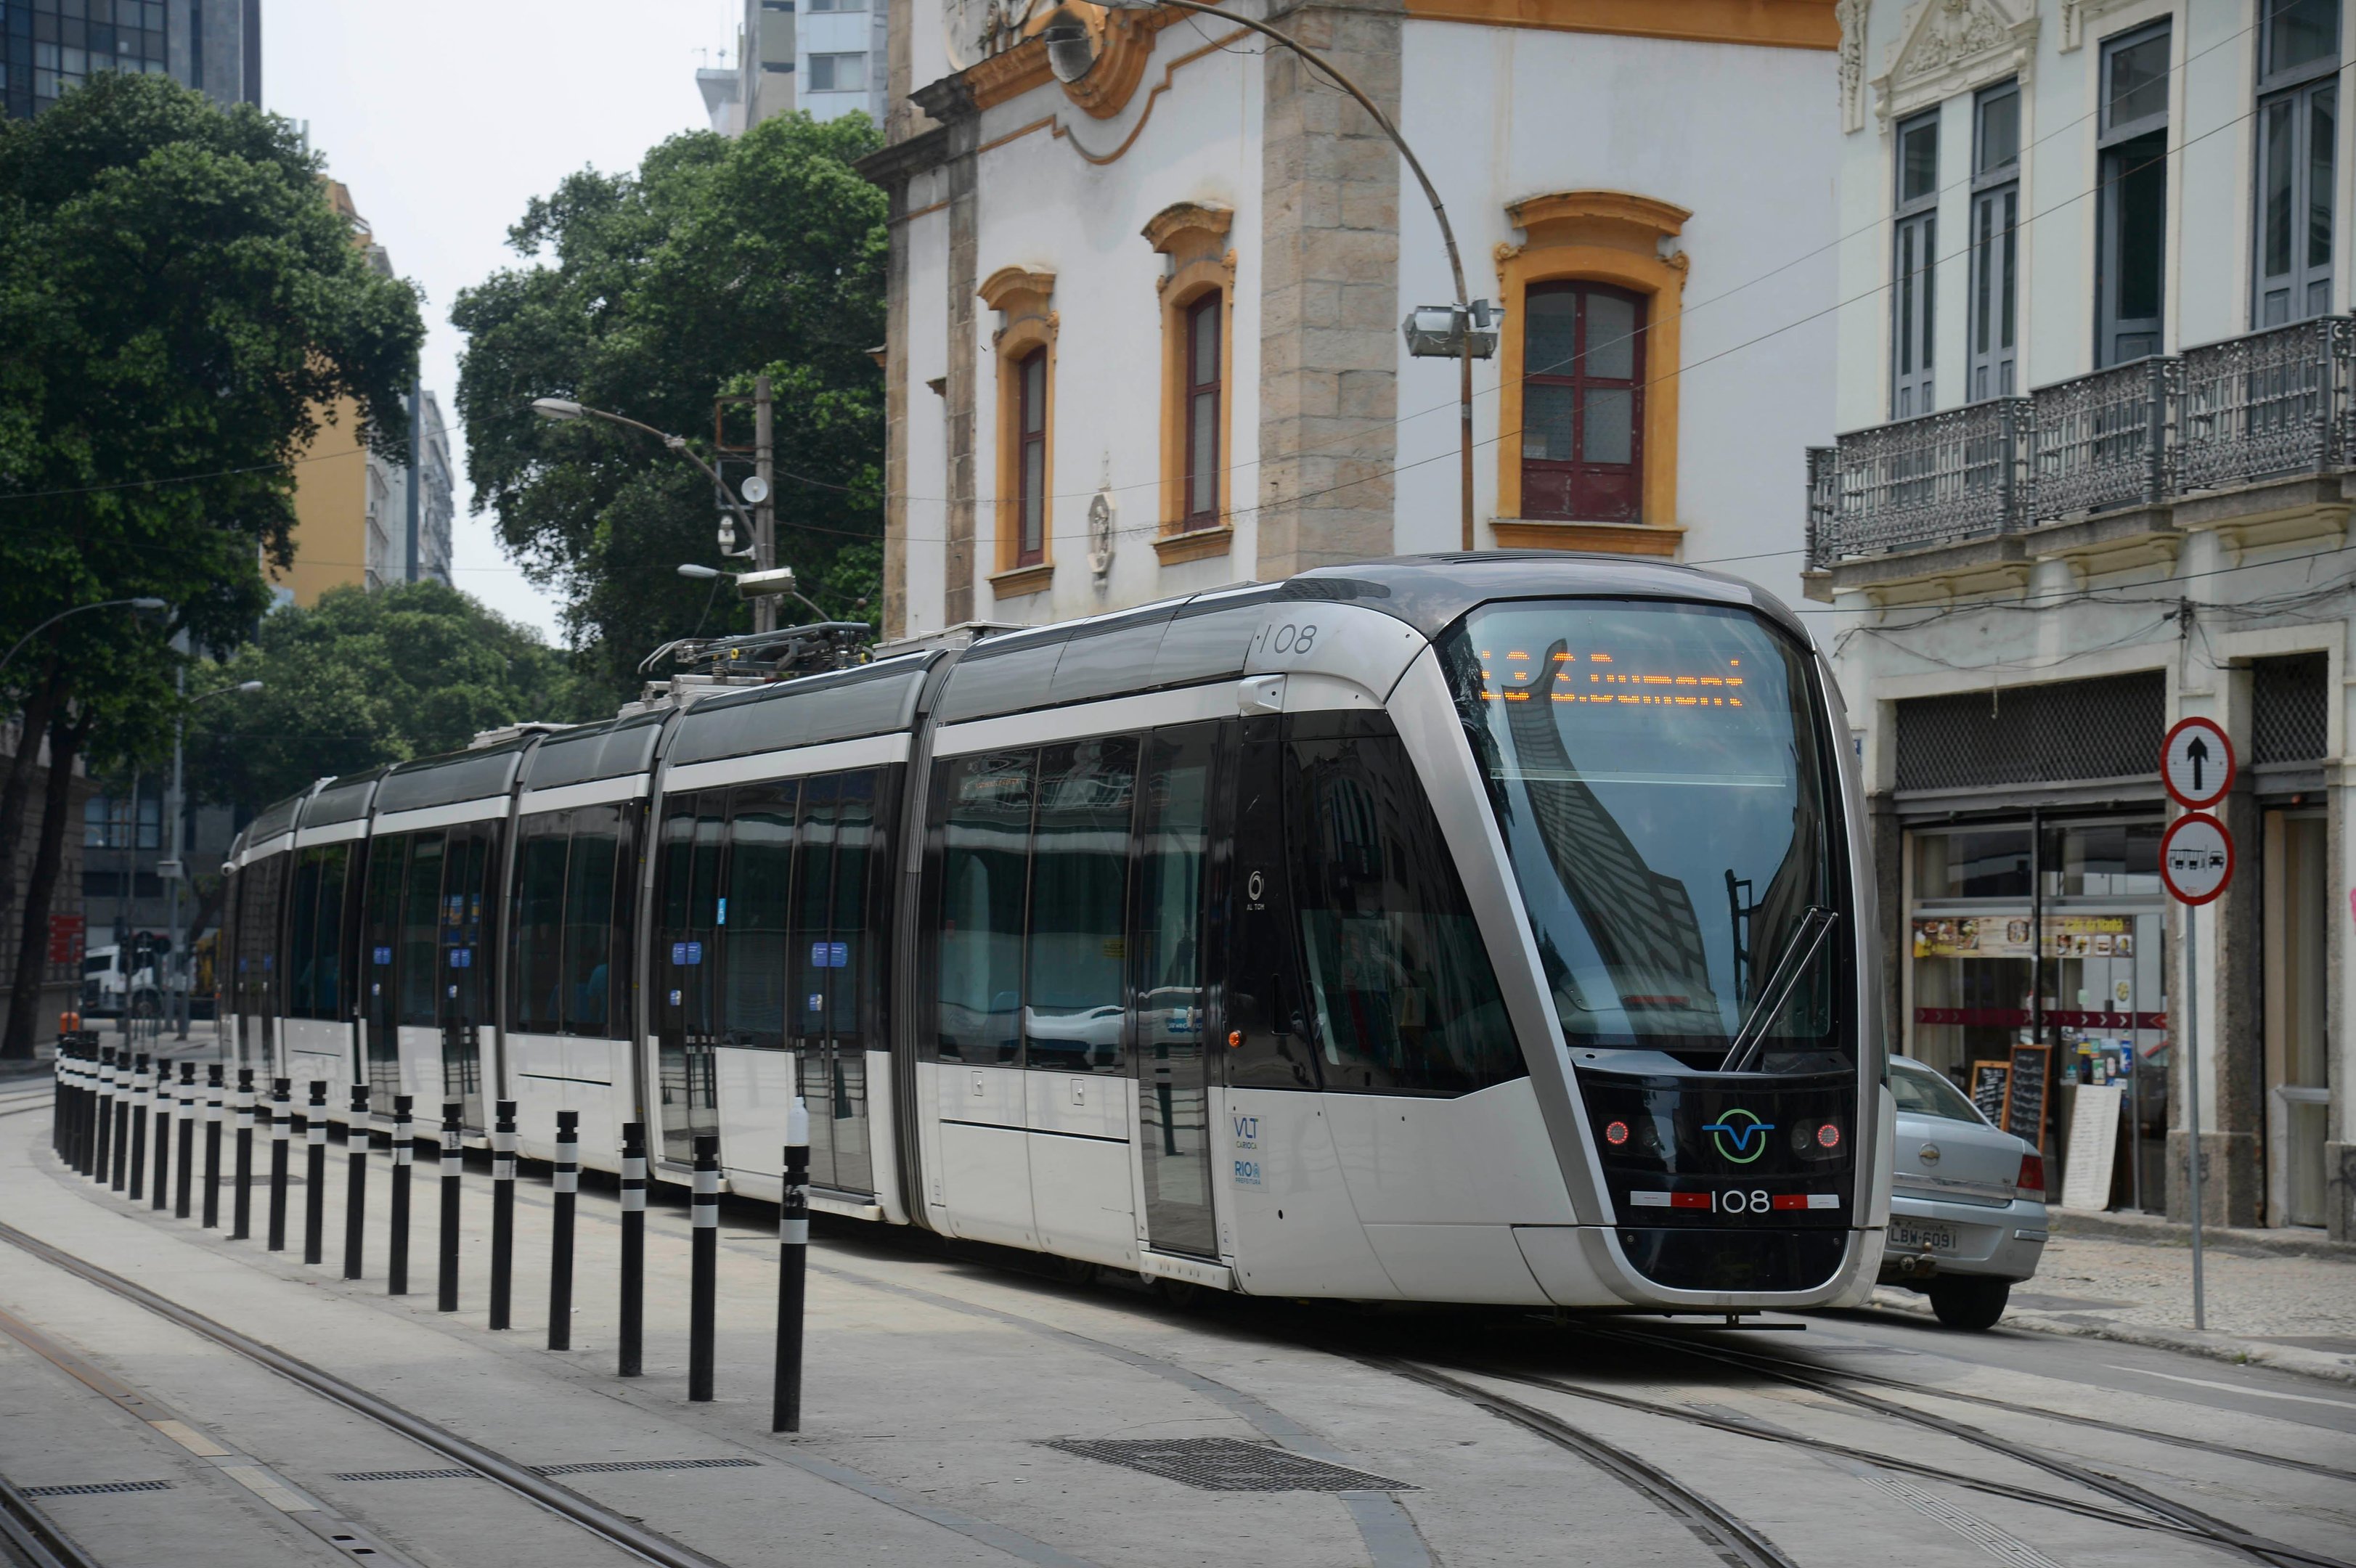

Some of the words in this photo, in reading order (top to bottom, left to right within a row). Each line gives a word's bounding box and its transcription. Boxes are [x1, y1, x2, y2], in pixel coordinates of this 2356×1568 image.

[1259, 624, 1317, 654] 108
[1234, 1116, 1259, 1139] VLT
[1234, 1161, 1252, 1177] RIO
[1711, 1190, 1770, 1213] 108
